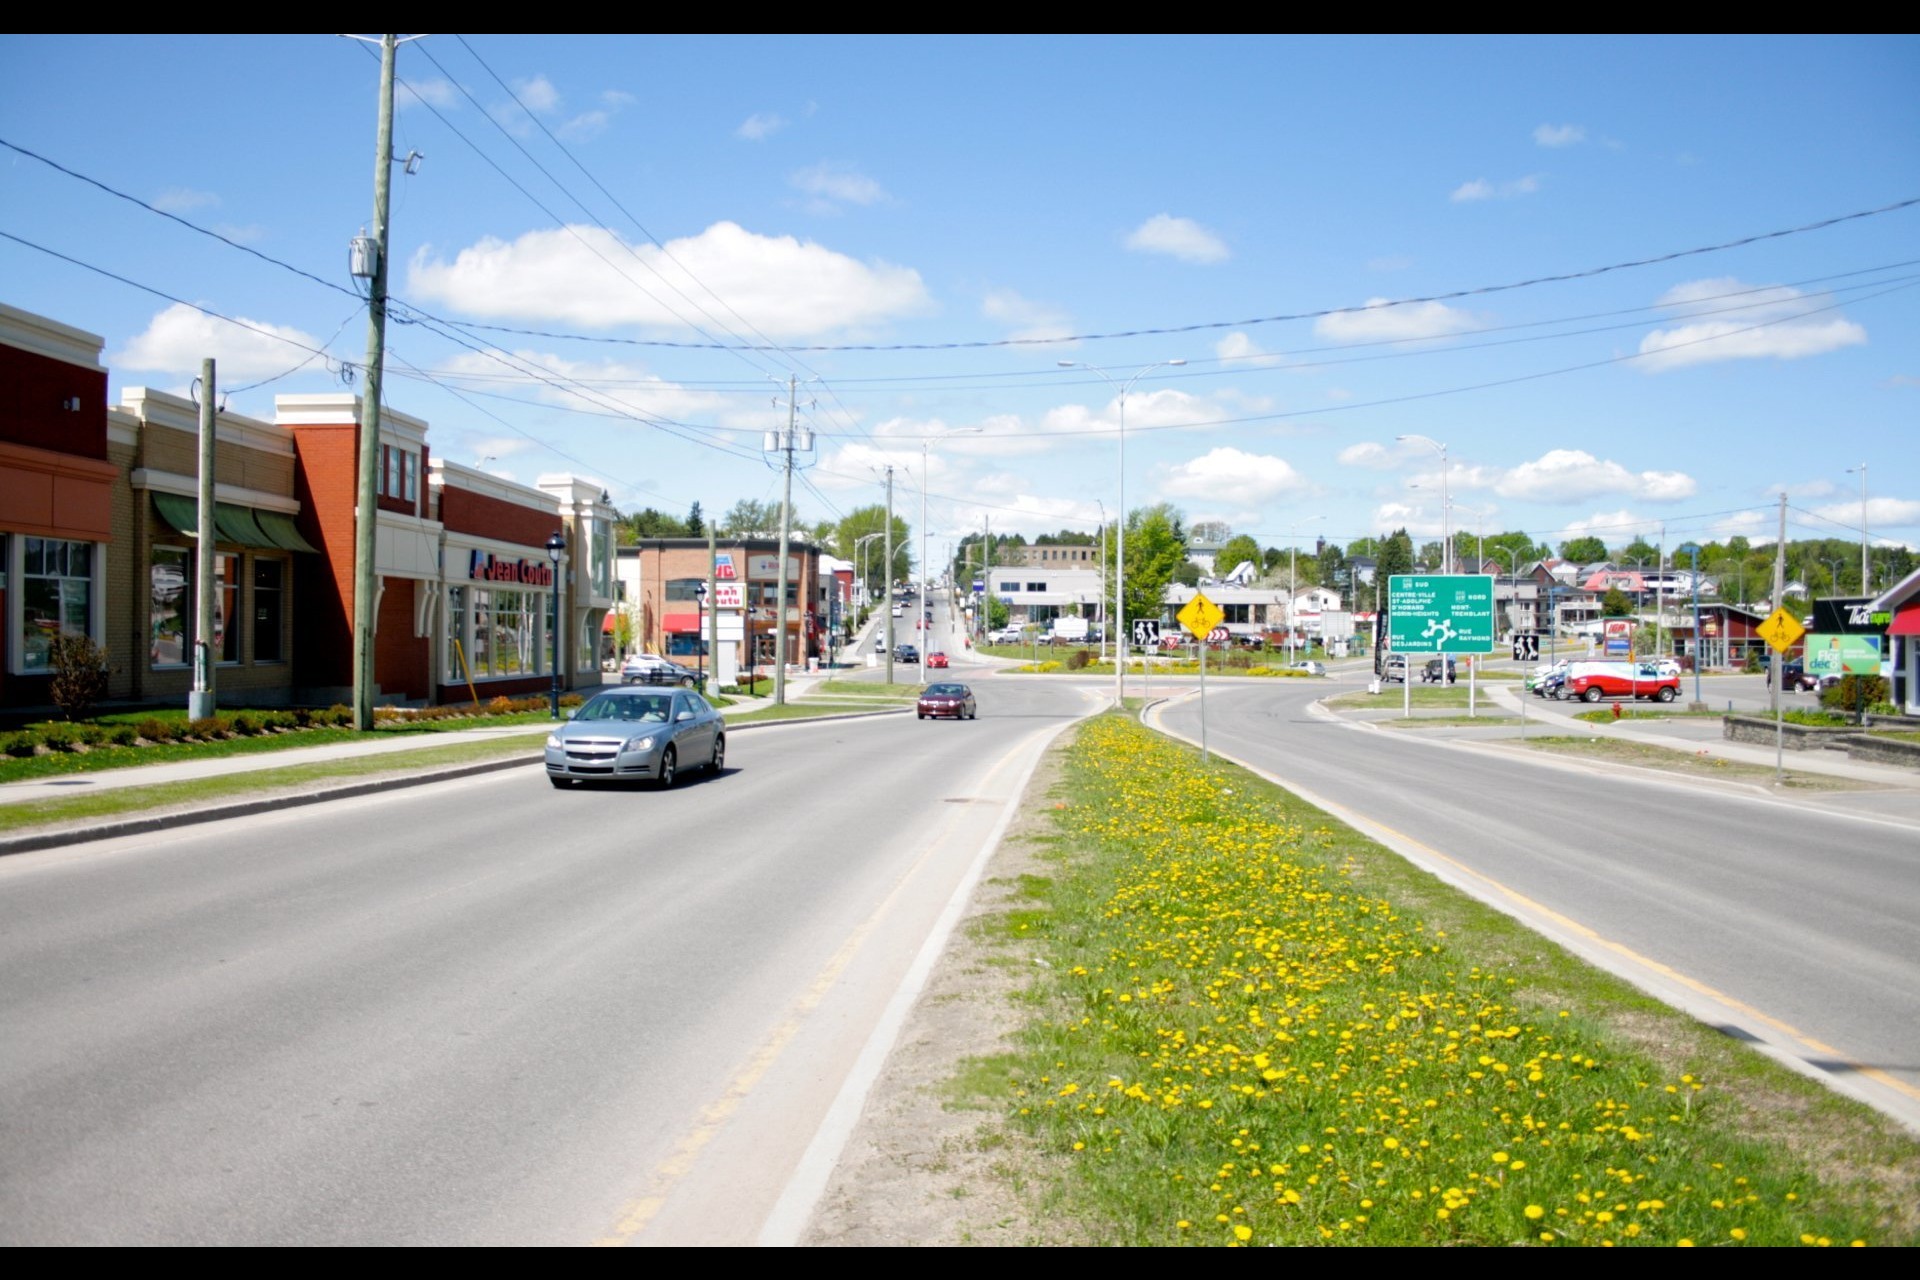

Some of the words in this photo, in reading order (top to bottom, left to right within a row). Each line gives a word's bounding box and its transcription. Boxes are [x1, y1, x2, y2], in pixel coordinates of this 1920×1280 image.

[485, 553, 518, 582] Jean
[518, 558, 554, 586] Coutu
[1844, 605, 1872, 625] Thai
[1608, 623, 1626, 633] IGA
